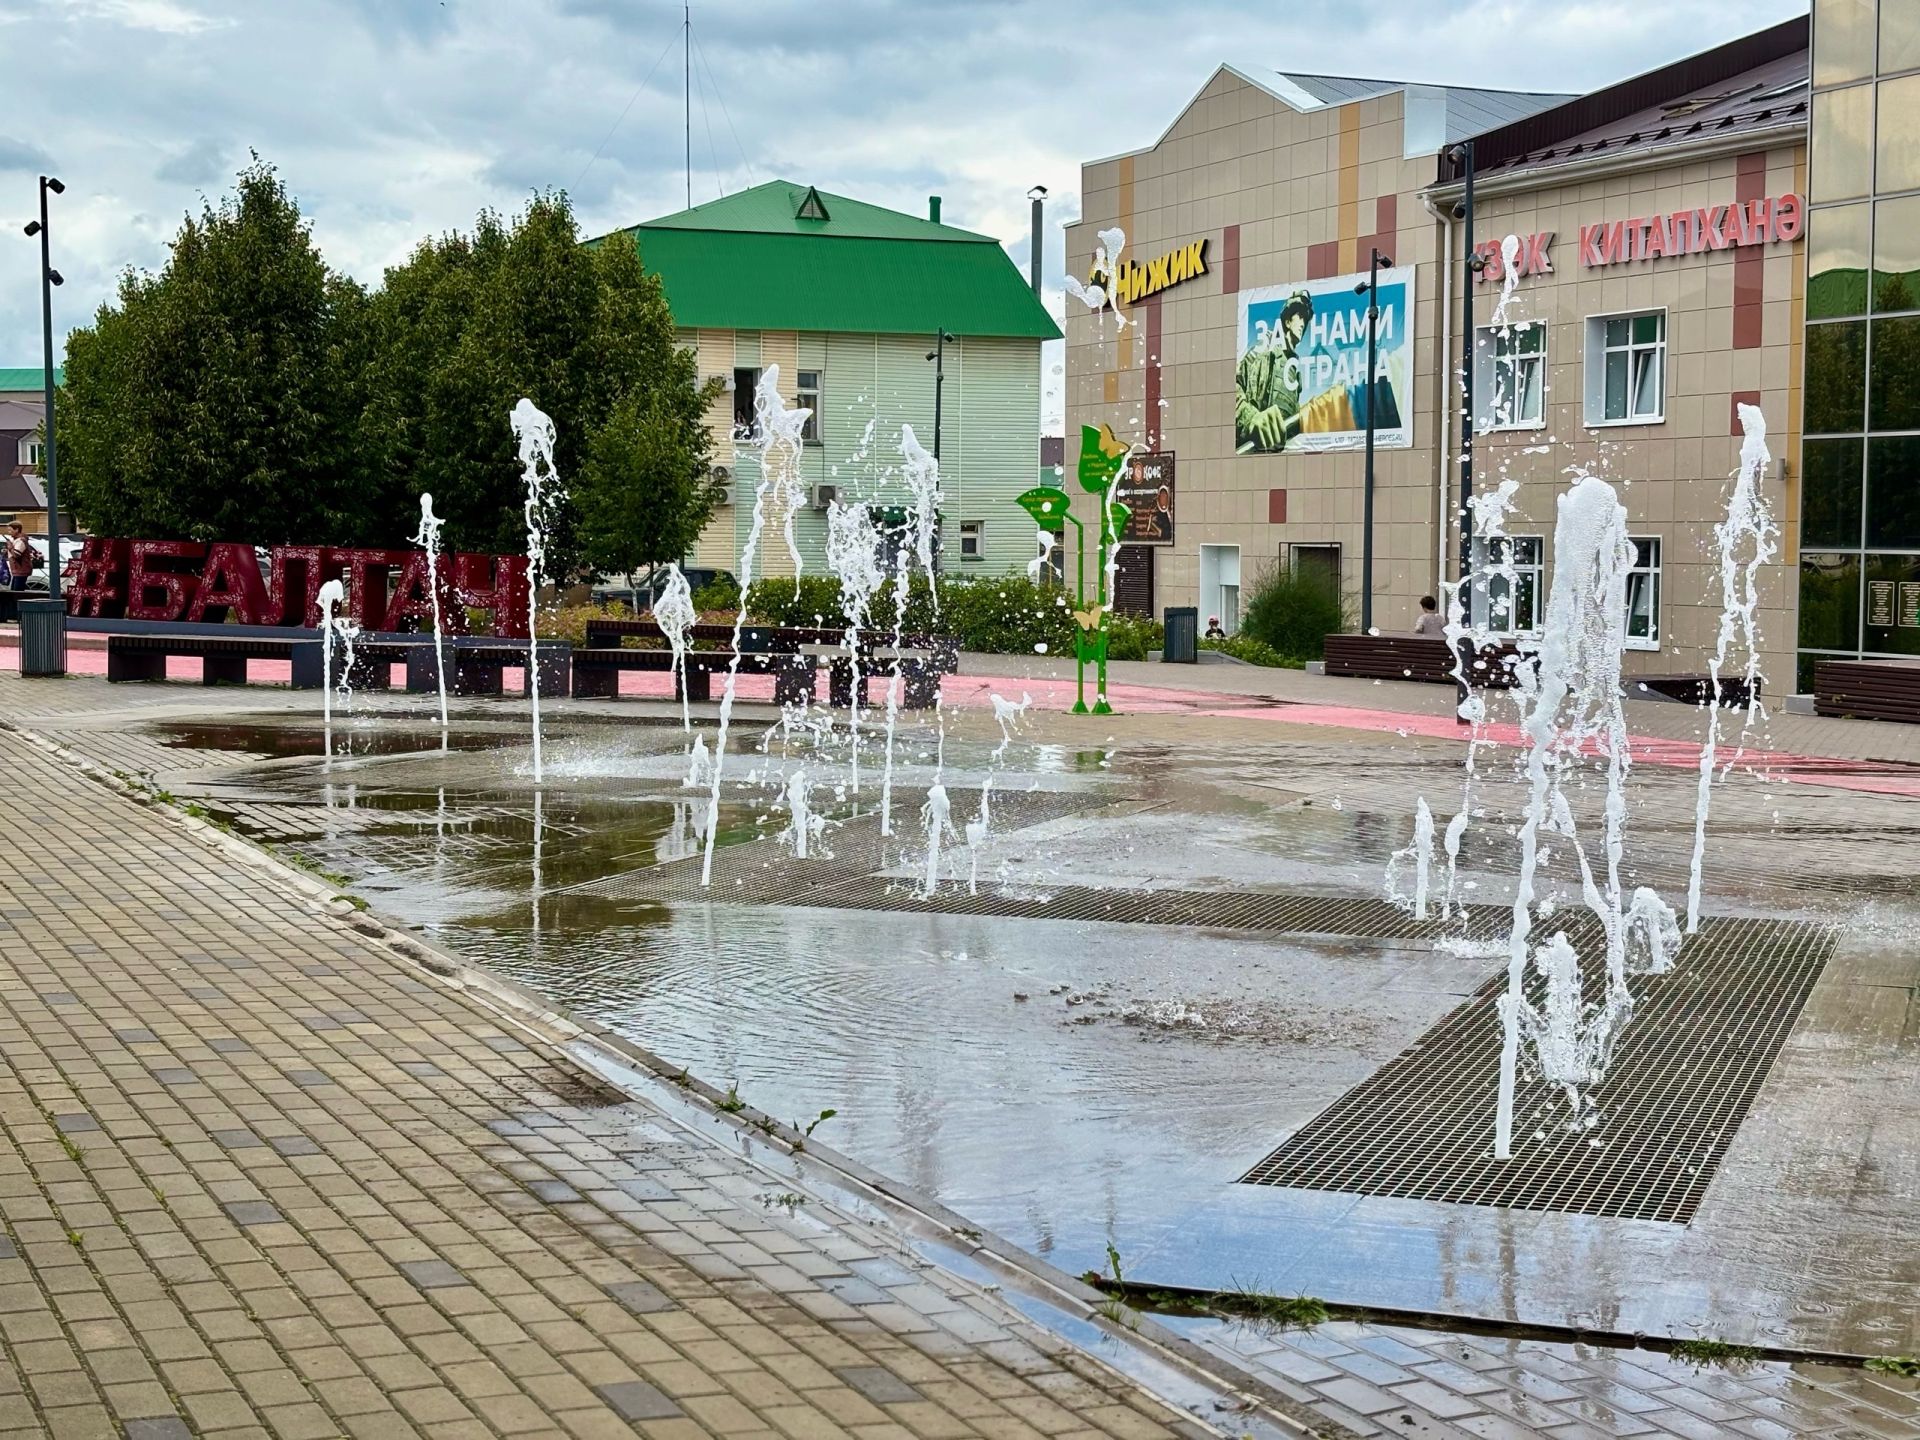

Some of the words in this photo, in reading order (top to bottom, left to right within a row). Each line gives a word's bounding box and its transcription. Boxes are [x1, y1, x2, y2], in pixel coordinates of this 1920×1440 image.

[1580, 193, 1805, 267] КИТАПХАНӘ
[1255, 318, 1287, 351] ЗА
[1311, 304, 1393, 347] НАМИ
[1284, 349, 1392, 391] СТРАНА
[66, 538, 533, 639] #БАЛТАЧ
